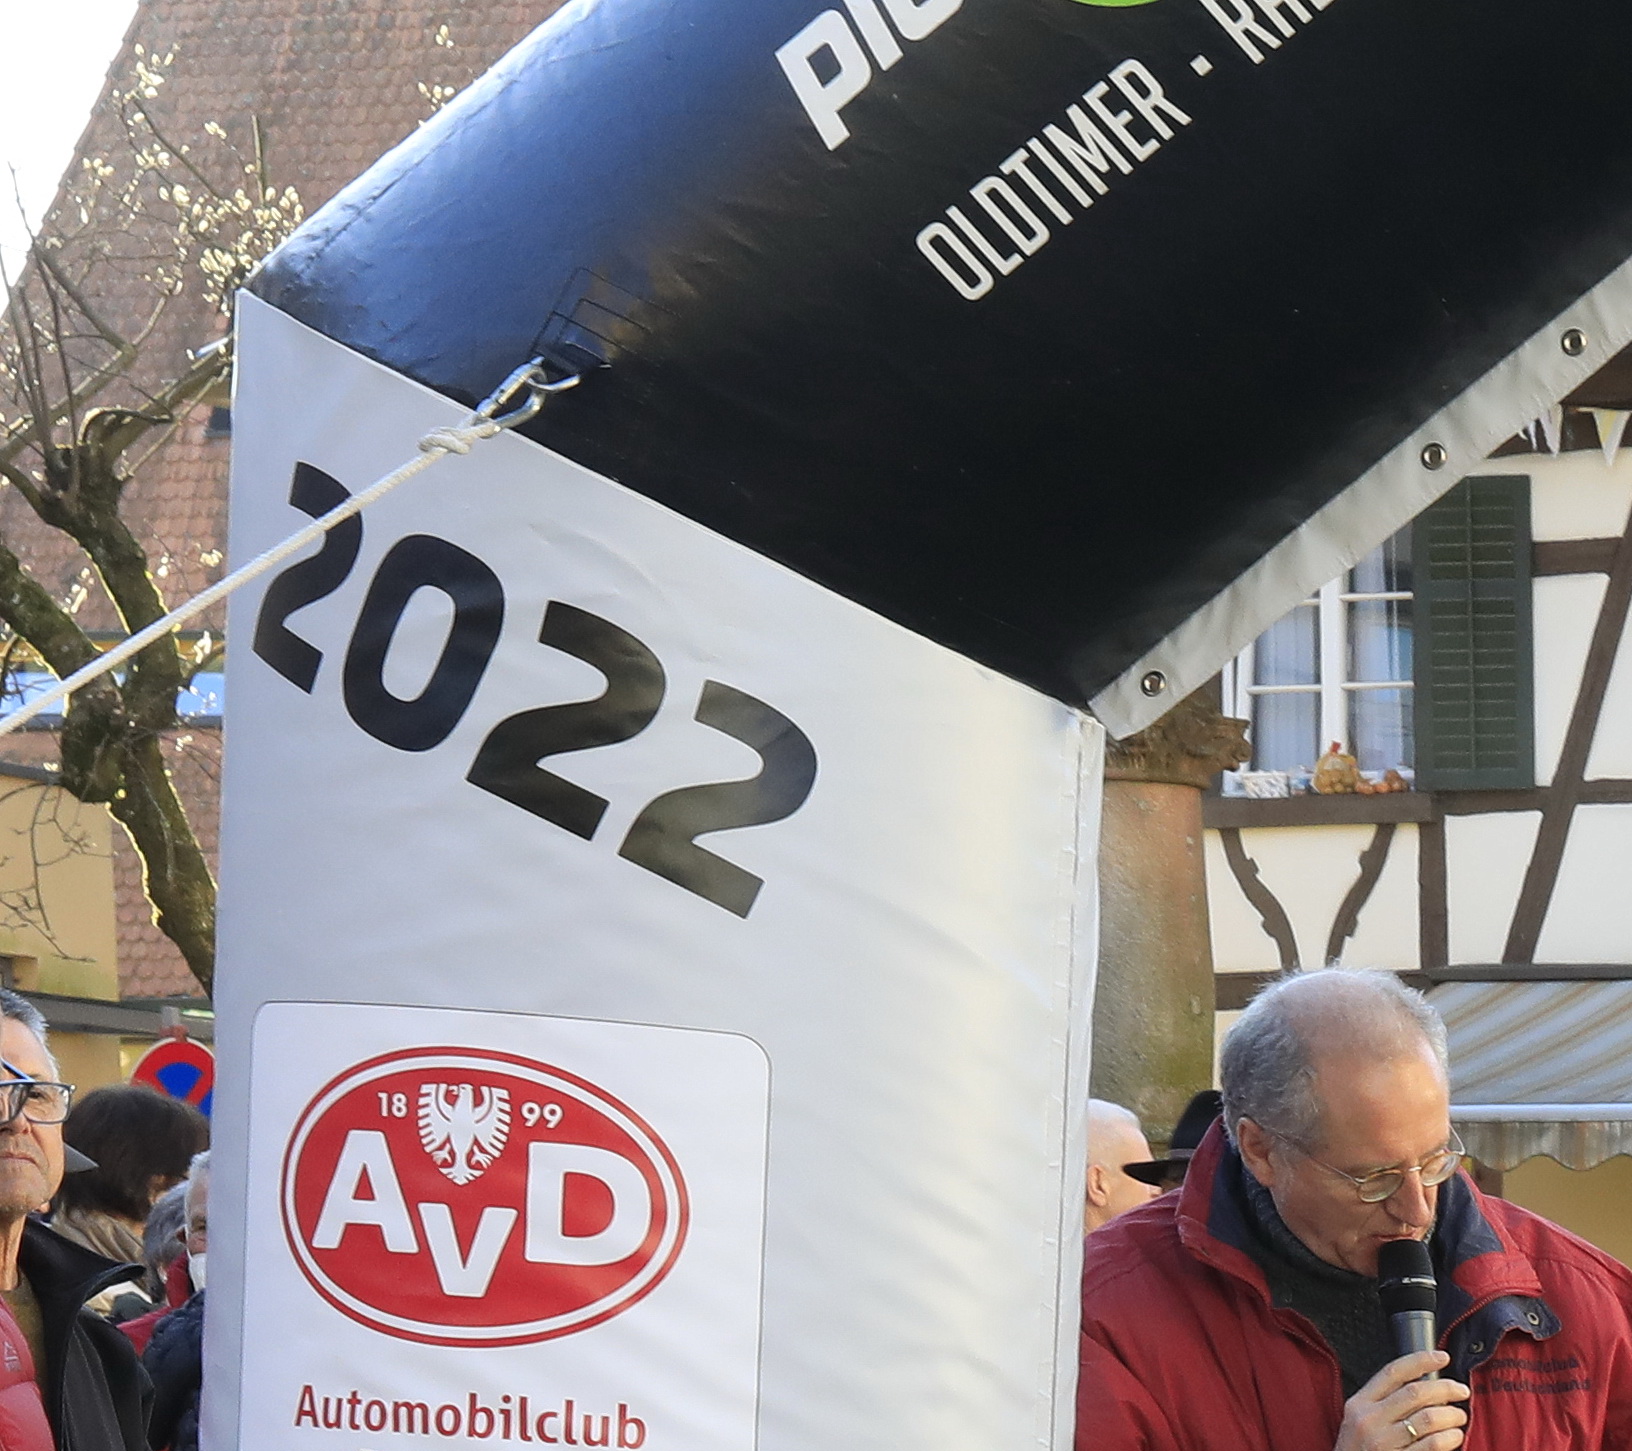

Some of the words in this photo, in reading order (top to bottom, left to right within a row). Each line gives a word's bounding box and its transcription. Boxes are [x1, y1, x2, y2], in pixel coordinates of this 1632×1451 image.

[915, 58, 1192, 301] OLDTIMER
[251, 460, 819, 920] 2022
[377, 1091, 408, 1119] 18
[520, 1101, 564, 1130] 99
[293, 1383, 648, 1450] Automobilclub
